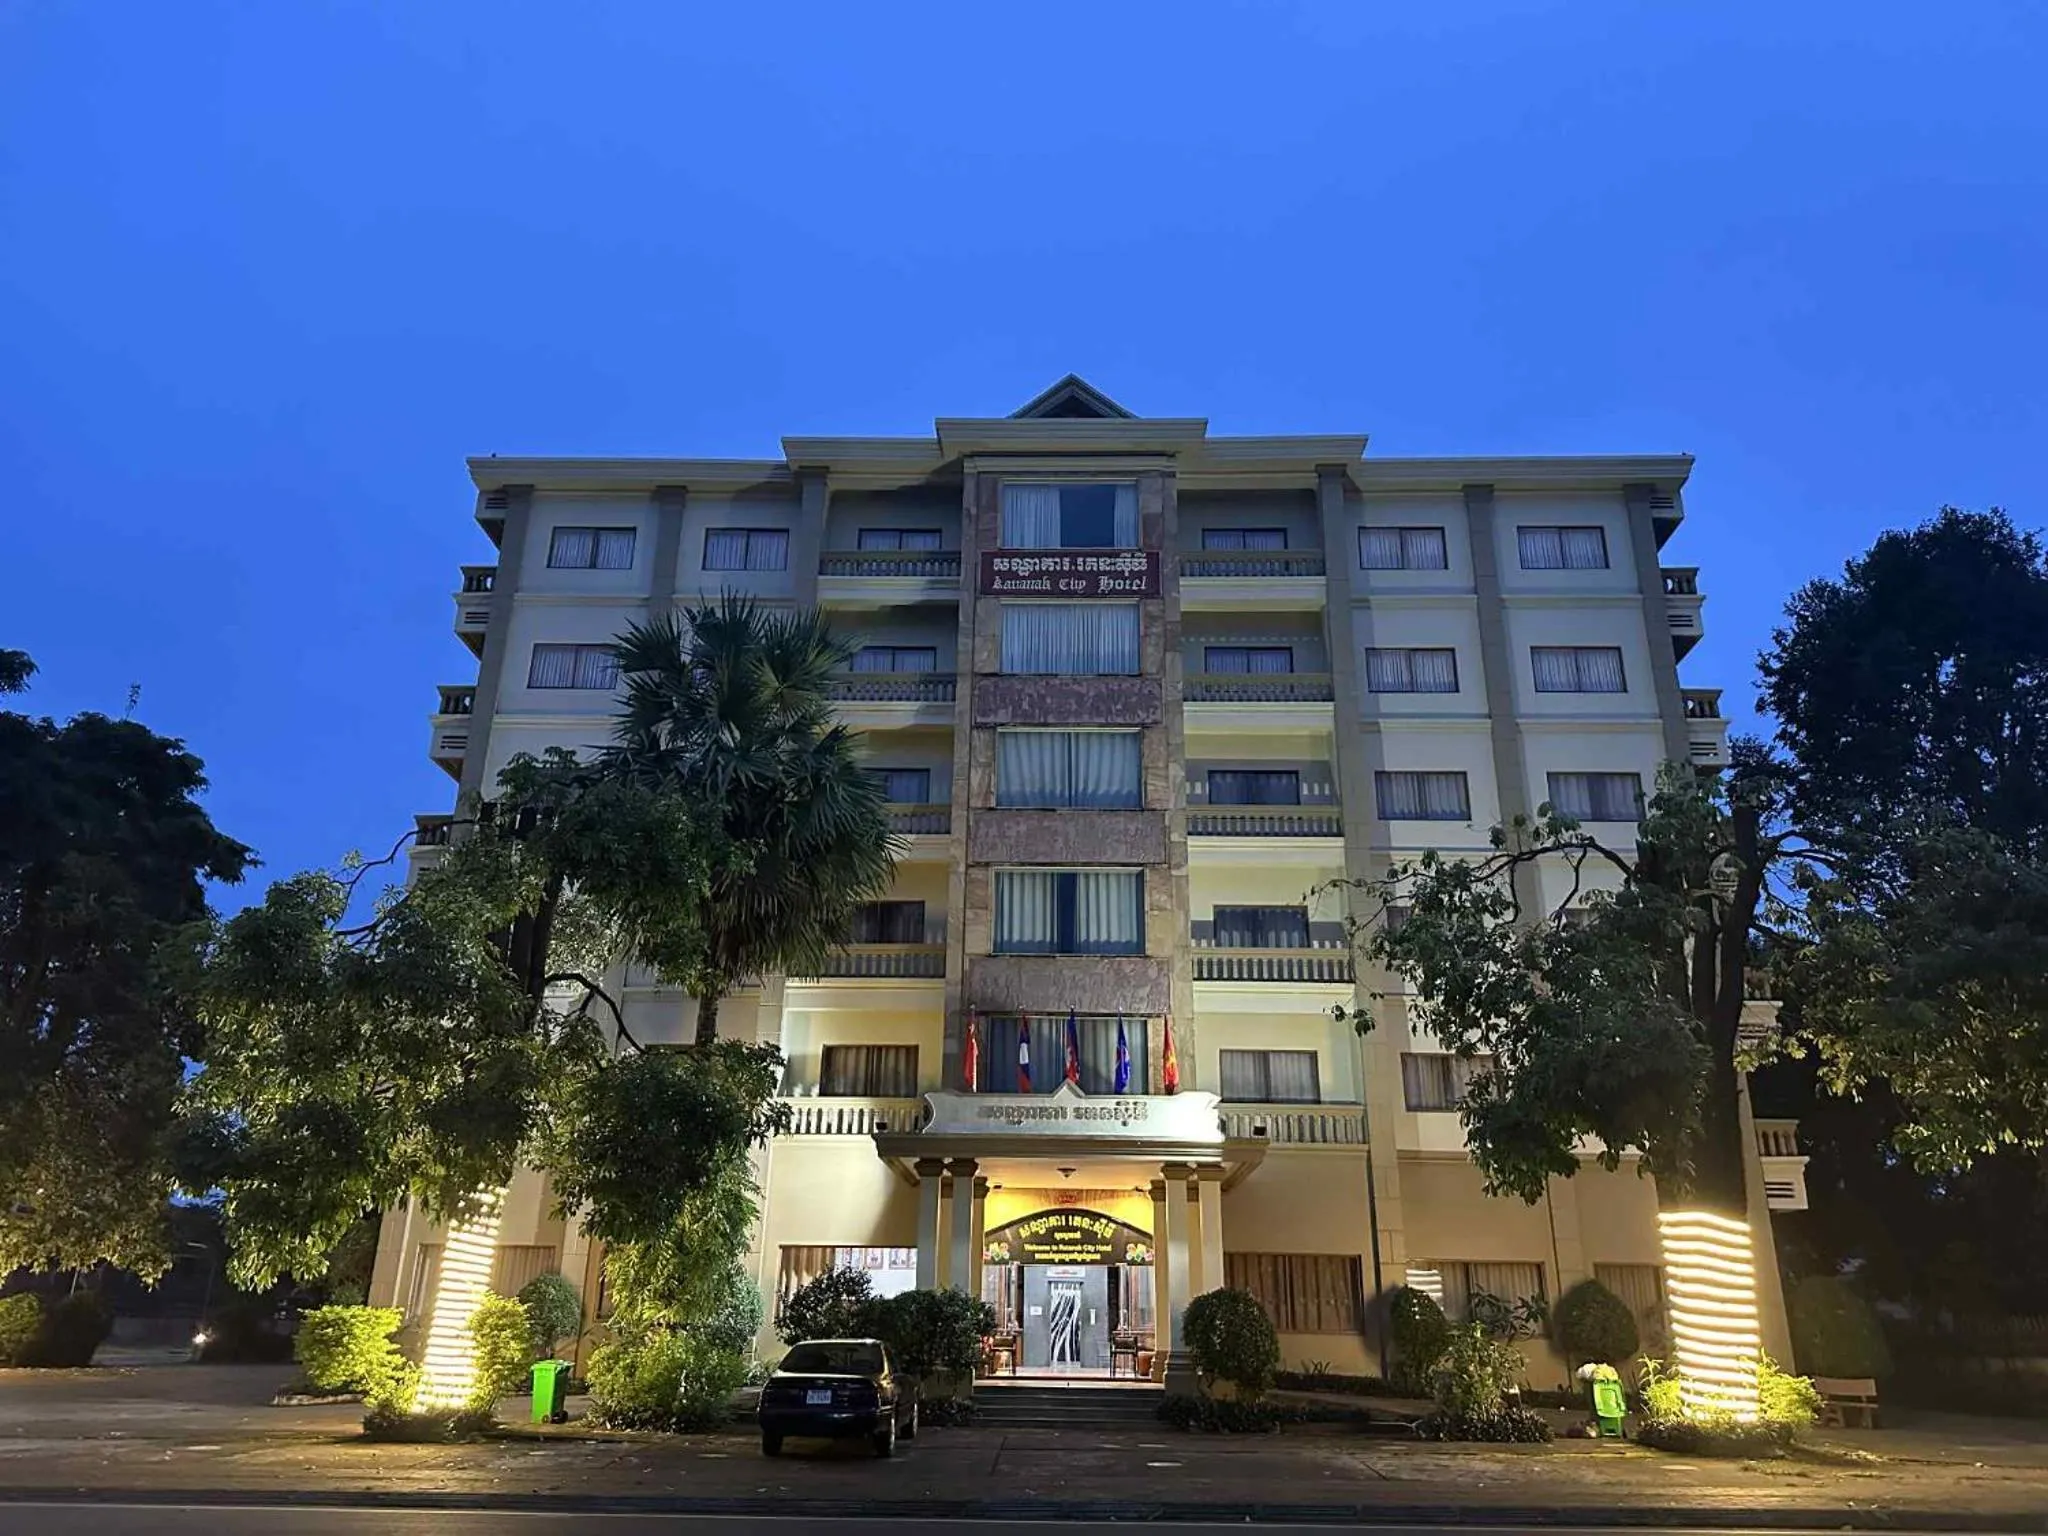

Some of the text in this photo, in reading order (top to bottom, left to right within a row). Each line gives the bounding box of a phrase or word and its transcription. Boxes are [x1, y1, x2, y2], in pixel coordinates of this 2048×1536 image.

[1058, 577, 1087, 593] City
[1098, 575, 1147, 593] Hotel
[1083, 1244, 1096, 1252] City
